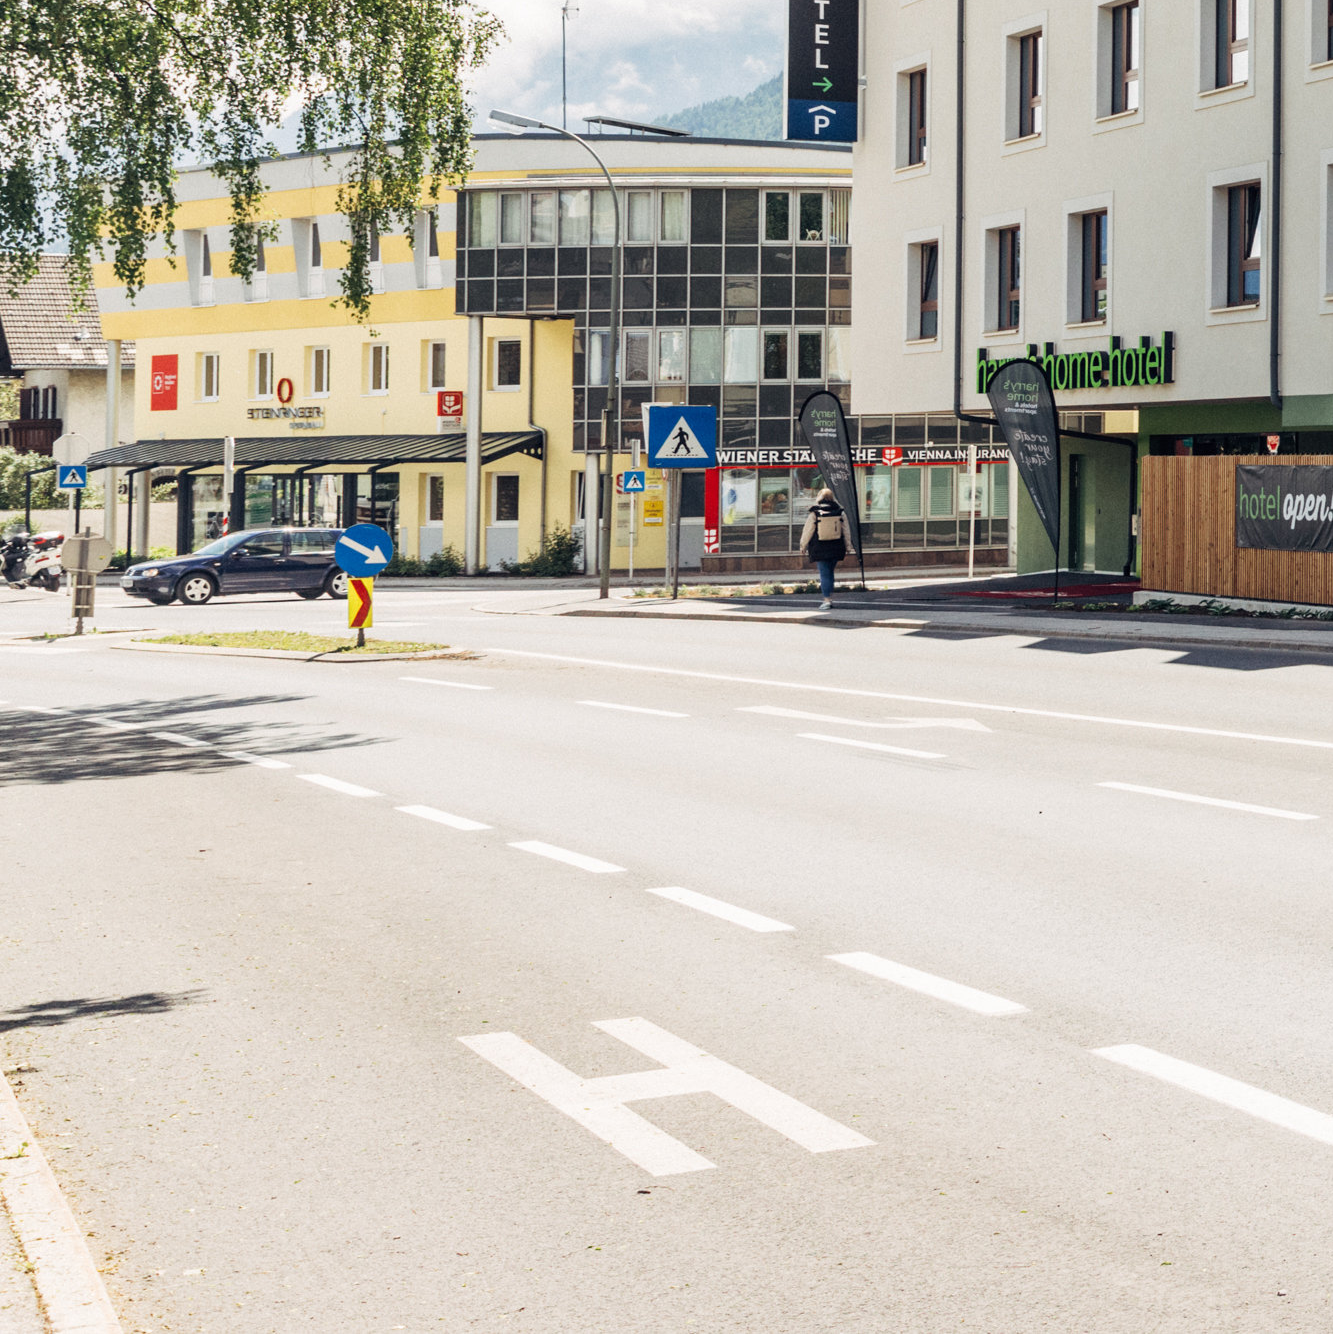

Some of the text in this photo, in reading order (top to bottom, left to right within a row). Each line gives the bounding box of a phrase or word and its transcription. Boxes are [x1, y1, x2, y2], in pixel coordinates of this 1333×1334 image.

[814, 115, 830, 135] P
[1043, 342, 1108, 390] home
[1109, 331, 1174, 387] hotel
[716, 450, 780, 463] WIENER
[907, 449, 952, 460] VIENNA
[1239, 484, 1281, 520] hotel
[457, 1016, 877, 1177] H
